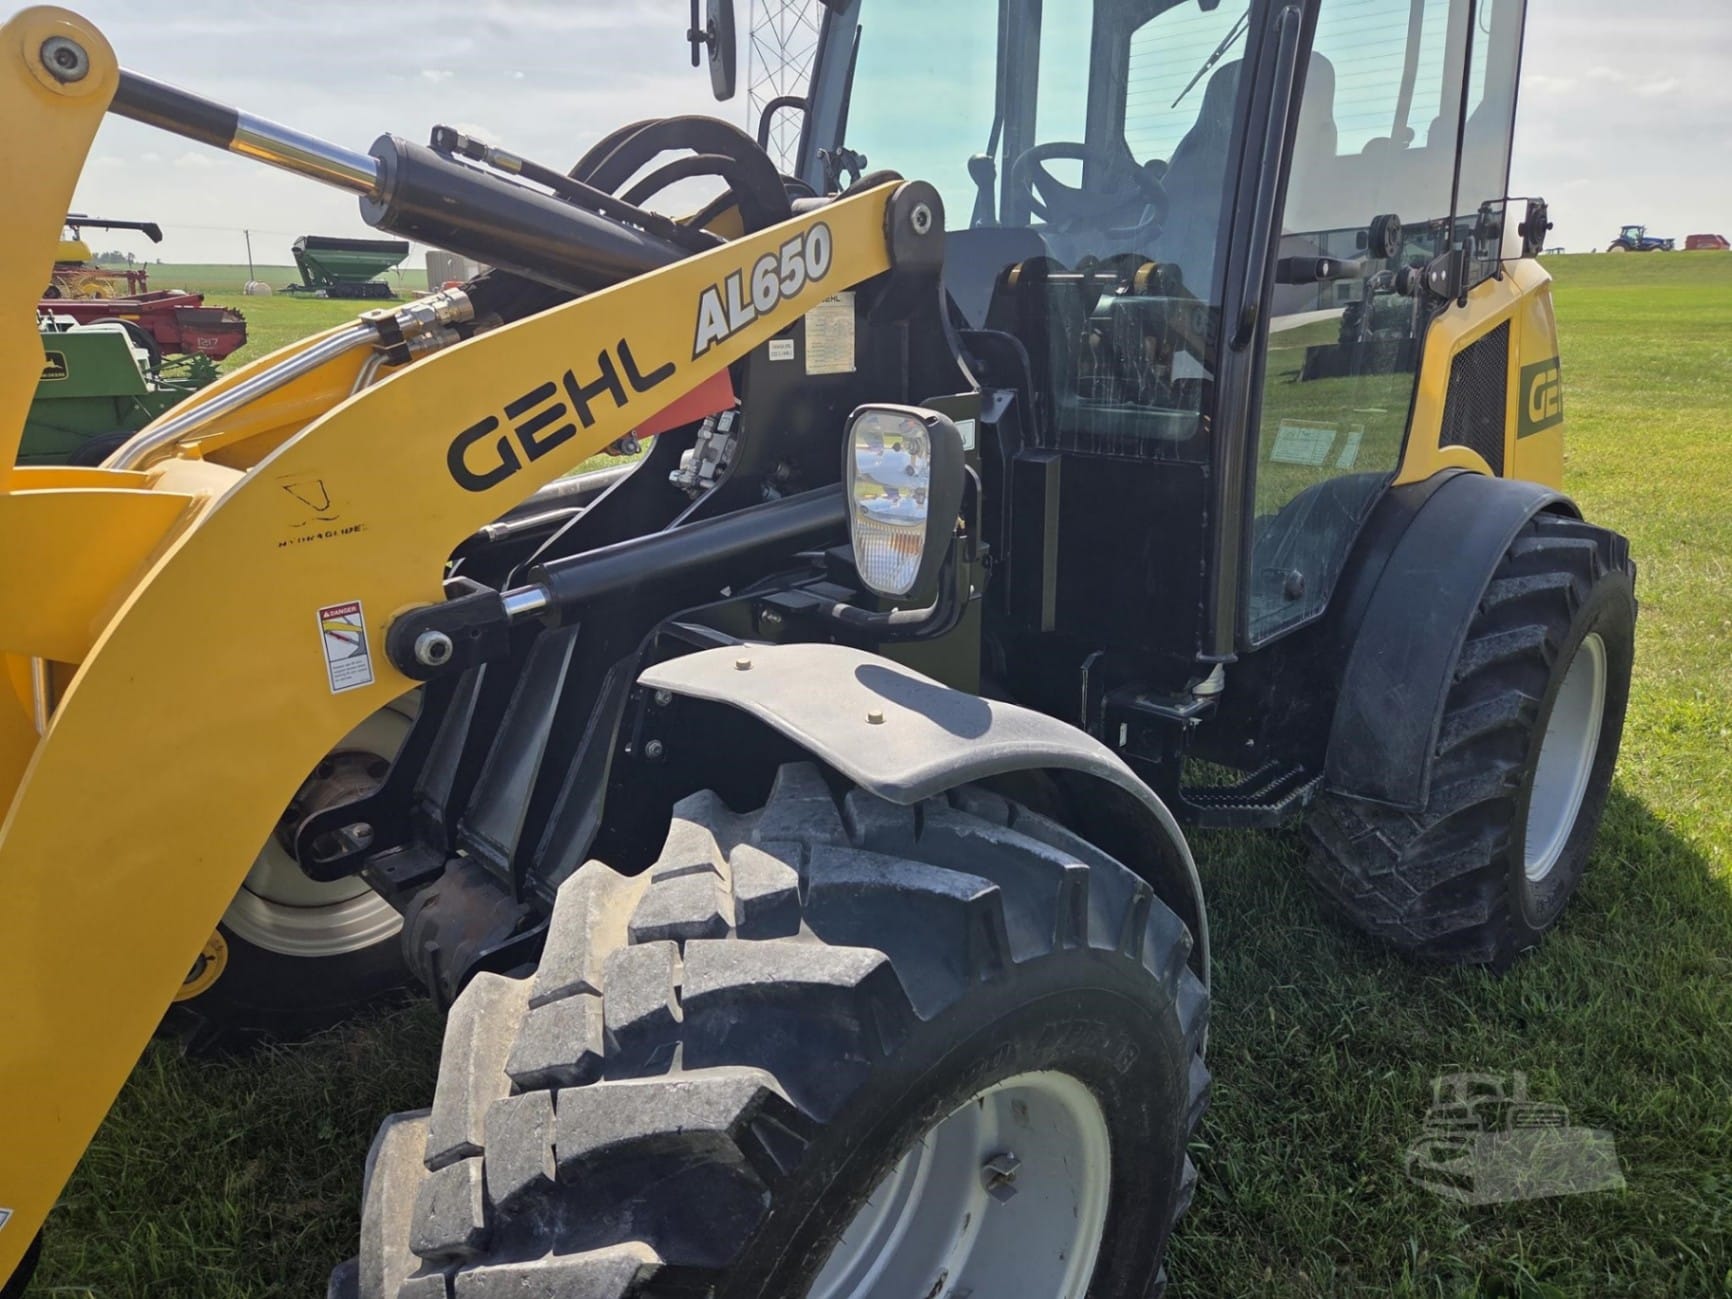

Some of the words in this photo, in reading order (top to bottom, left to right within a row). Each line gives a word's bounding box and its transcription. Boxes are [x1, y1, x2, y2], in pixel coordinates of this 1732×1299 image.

[447, 338, 676, 492] GEHL
[692, 221, 832, 361] AL650
[1529, 368, 1561, 423] GE
[278, 524, 362, 548] HDRAGLIDE
[330, 606, 357, 617] DANGER
